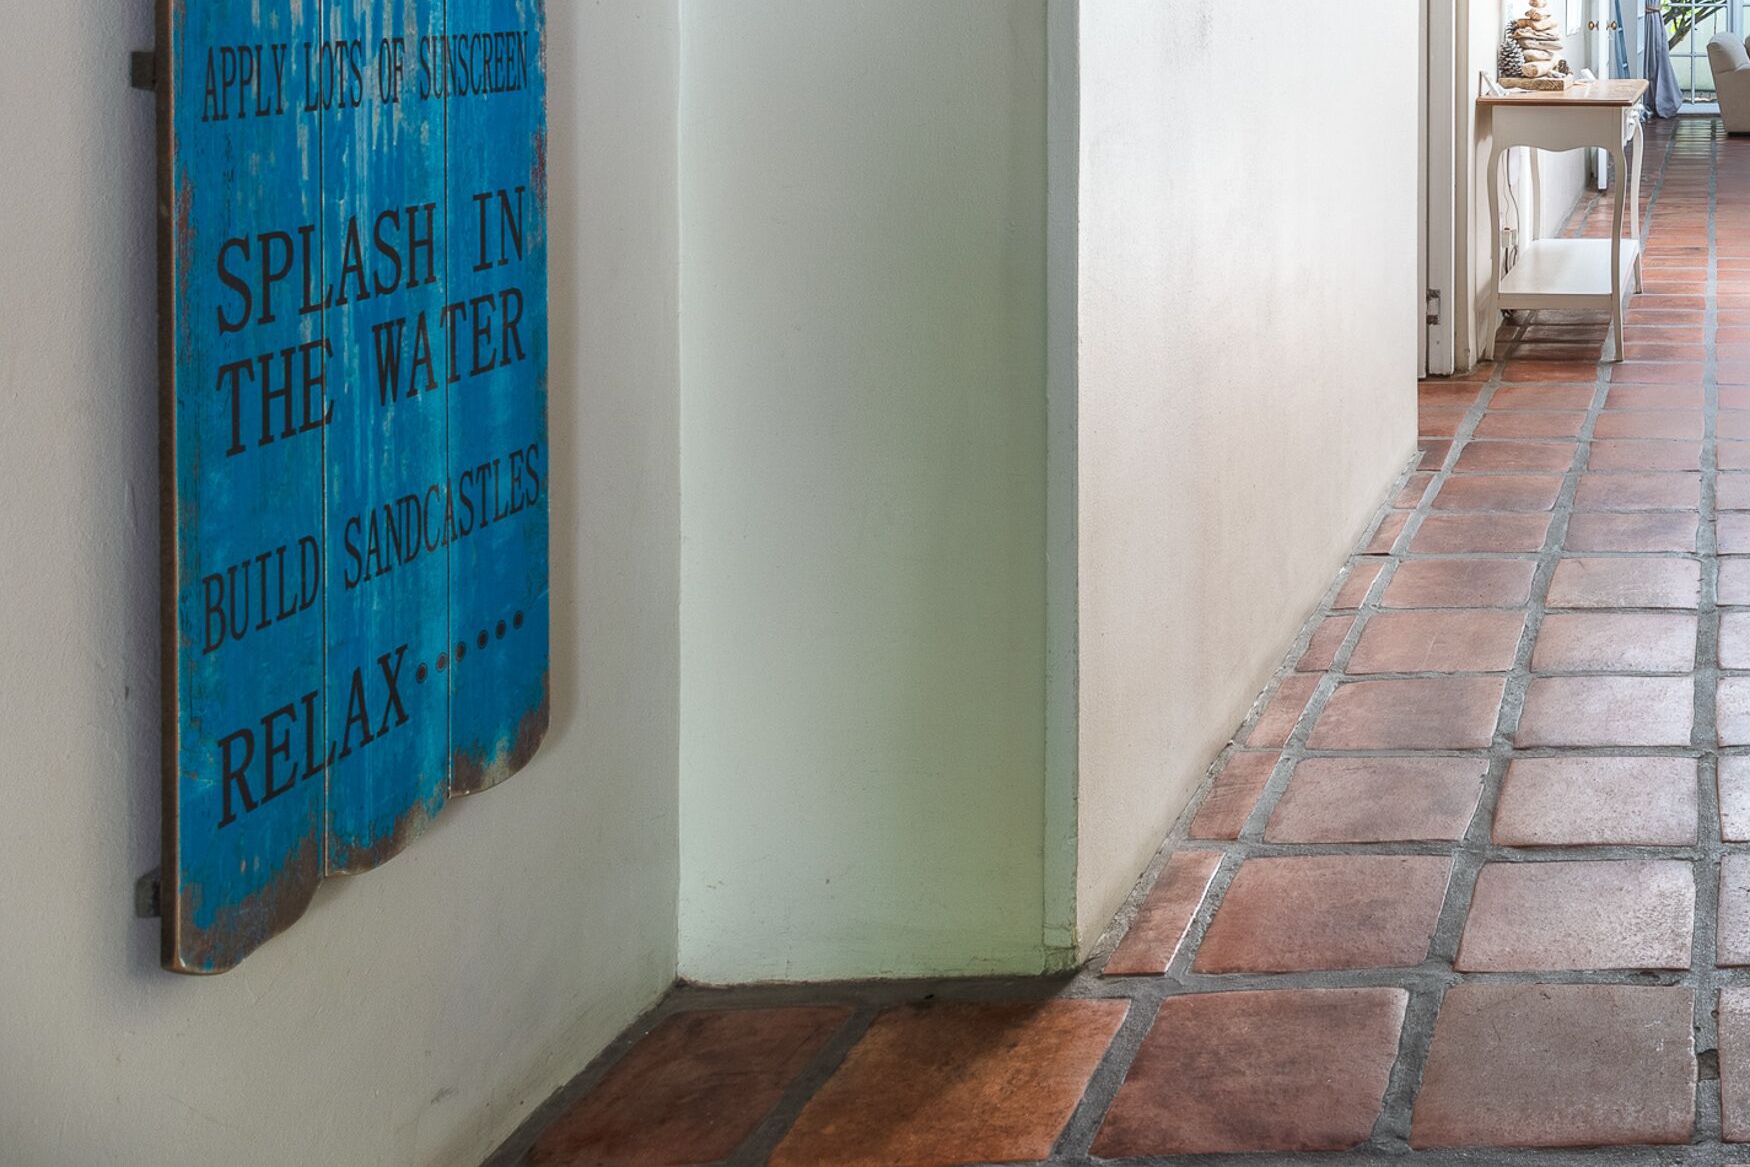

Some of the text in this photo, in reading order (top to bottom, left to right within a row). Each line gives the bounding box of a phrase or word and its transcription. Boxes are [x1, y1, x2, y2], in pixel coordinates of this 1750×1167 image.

[201, 30, 529, 122] APPLY LOTS OF SUNSCREEN
[216, 184, 527, 335] SPLASH IN
[215, 286, 527, 460] THE WATER
[202, 442, 541, 657] BUILD SANDCASTLES
